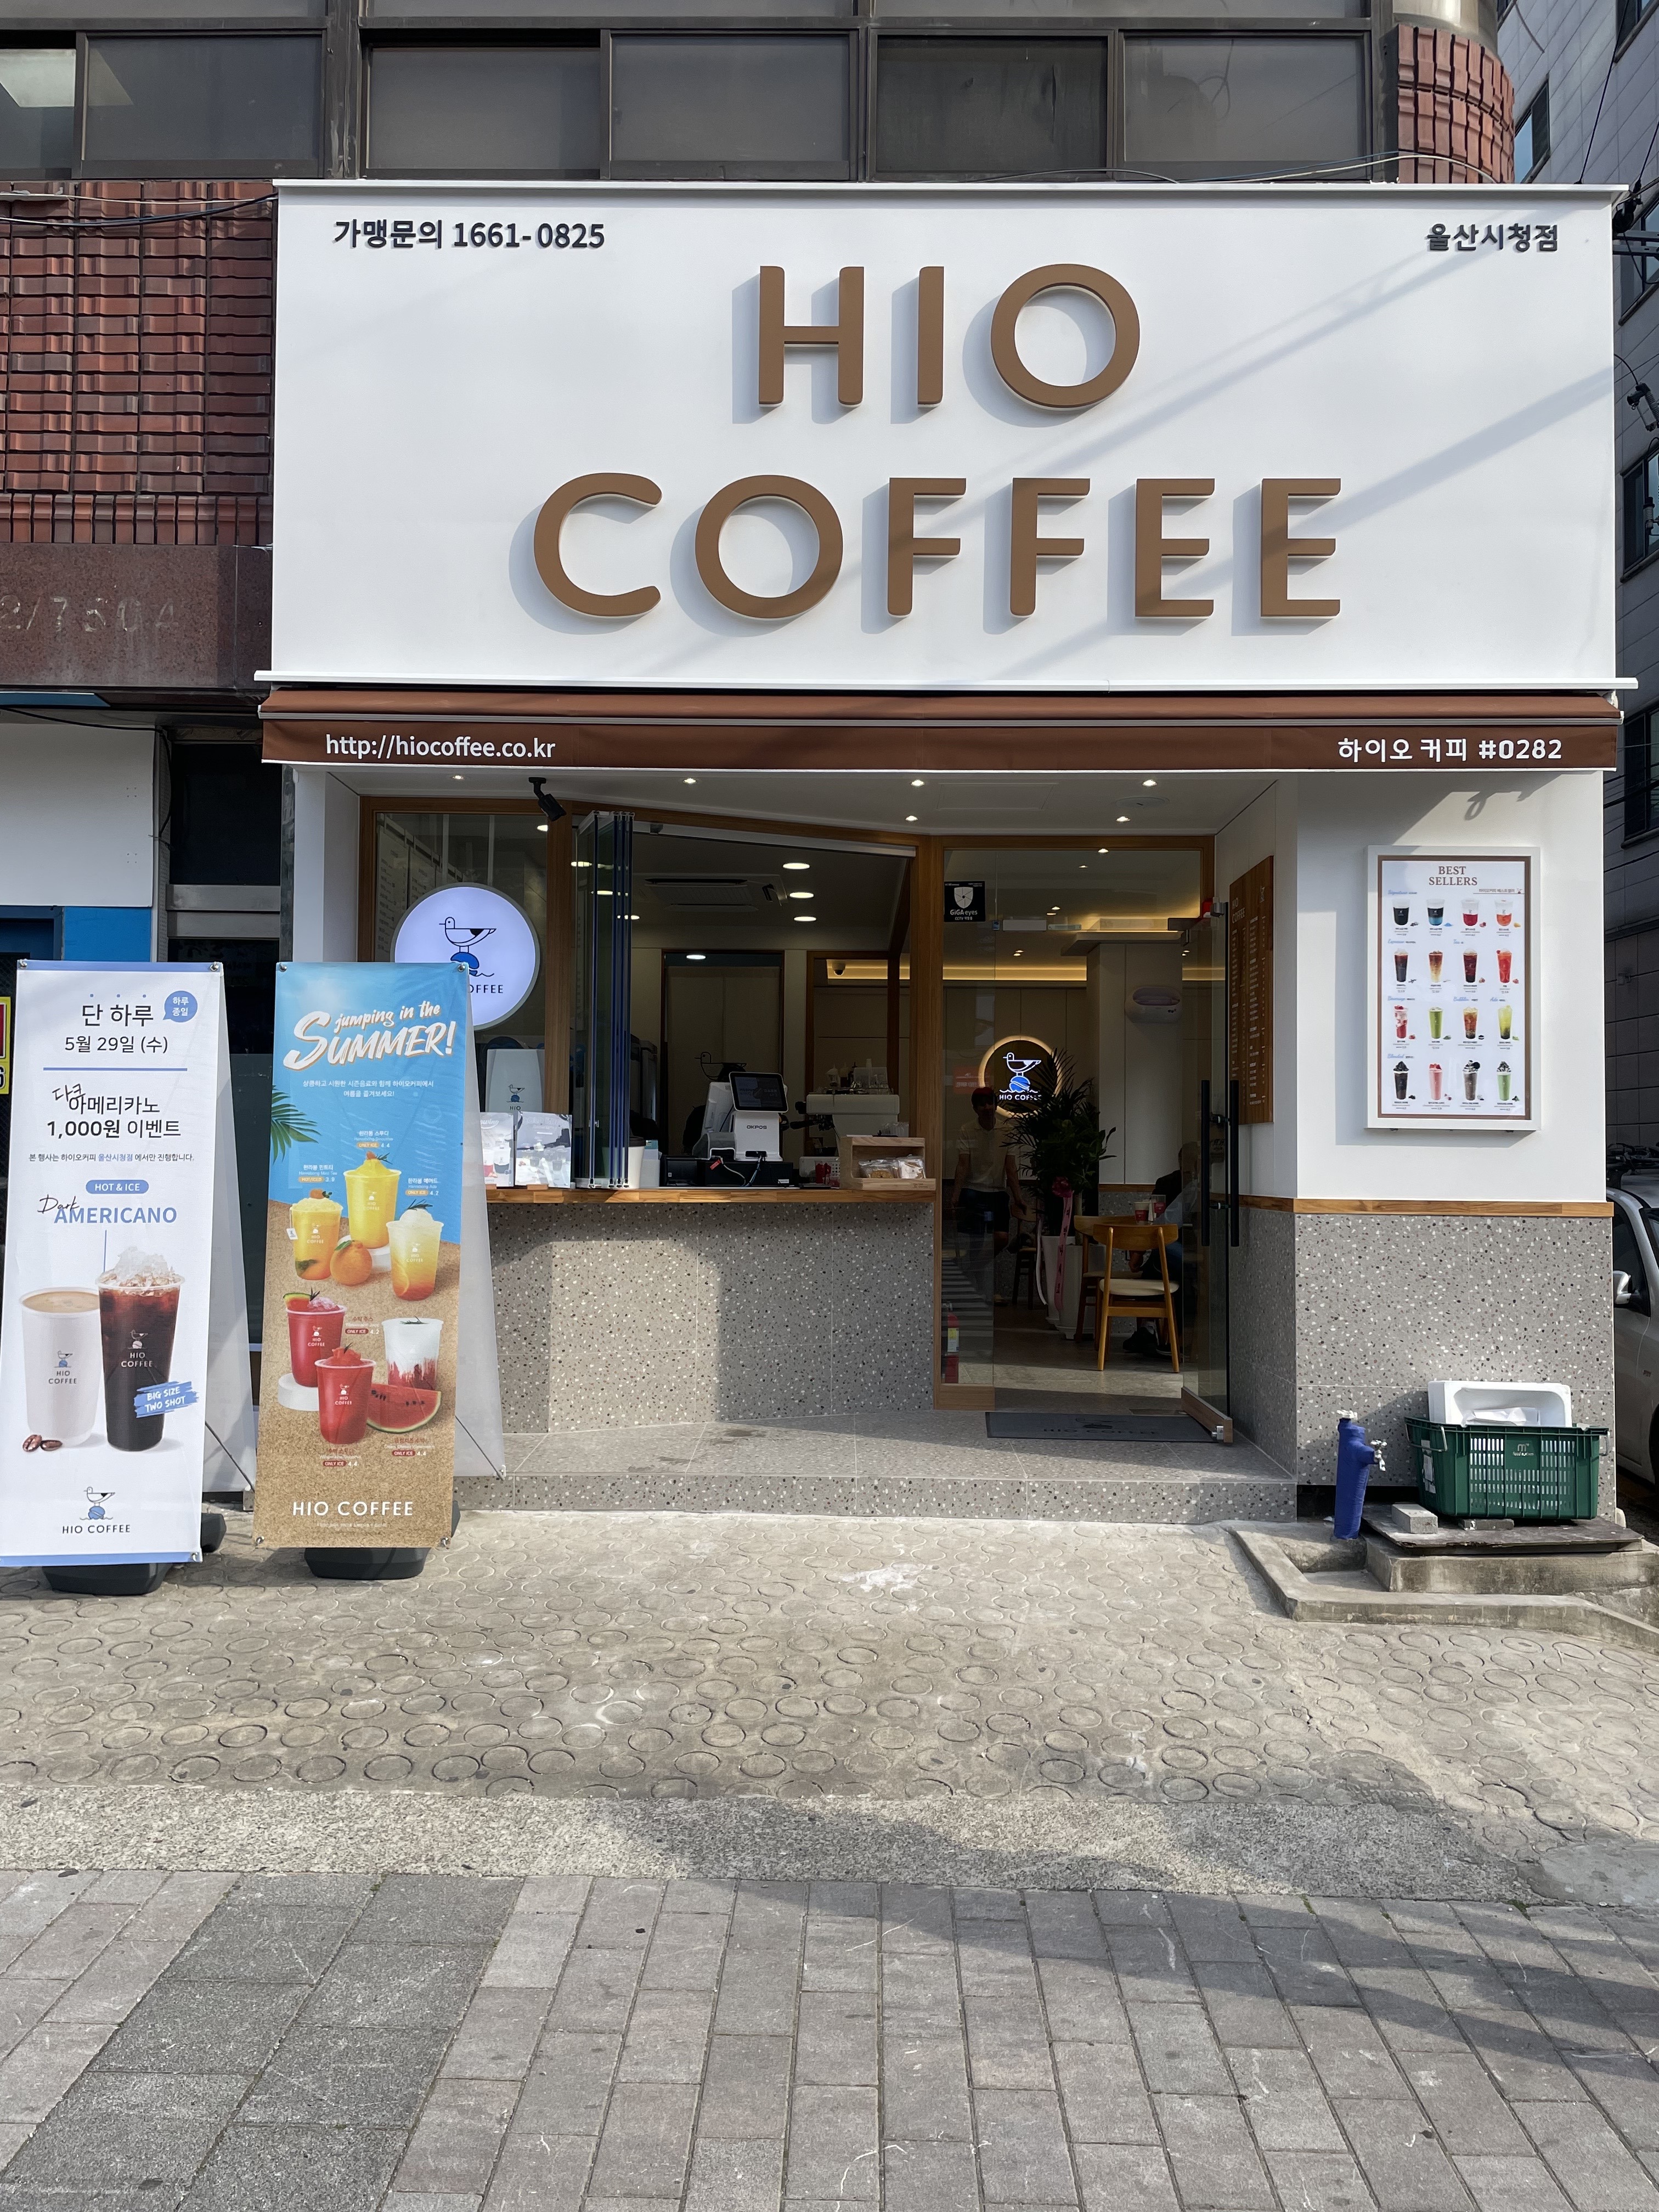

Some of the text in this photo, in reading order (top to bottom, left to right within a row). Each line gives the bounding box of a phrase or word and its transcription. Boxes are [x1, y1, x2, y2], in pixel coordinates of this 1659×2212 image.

[334, 219, 605, 249] 가맹문의 1661-0825
[1426, 223, 1558, 252] 울산시청점
[758, 263, 1141, 410] HIO
[533, 472, 1341, 619] COFFEE
[326, 734, 555, 759] http://hiocoffee.co.kr
[1338, 738, 1562, 763] 하이오 커피 #0282
[1438, 866, 1466, 875] BEST
[1429, 877, 1477, 885] SELLERS
[173, 996, 189, 1006] 하루
[82, 1003, 154, 1026] 단 하루
[172, 1007, 188, 1017] 종일
[334, 1000, 441, 1034] jumping in the
[65, 1036, 168, 1054] 5월 29일 (수)
[283, 1011, 457, 1071] SUMMER!
[69, 1096, 160, 1115] 아메리카노
[47, 1119, 181, 1139] 1,000원 이벤트
[29, 1154, 36, 1162] 본
[61, 1154, 96, 1162] 하이오커피
[134, 1154, 156, 1162] 에서만
[94, 1183, 140, 1192] HOT & ICE
[37, 1194, 80, 1214] Dark
[54, 1207, 177, 1223] AMERICANO
[146, 1386, 180, 1401] BIG SIZE
[144, 1396, 185, 1413] TWO SHOT
[292, 1501, 413, 1516] HIO COFFEE
[62, 1525, 131, 1534] HIO COFFEE
